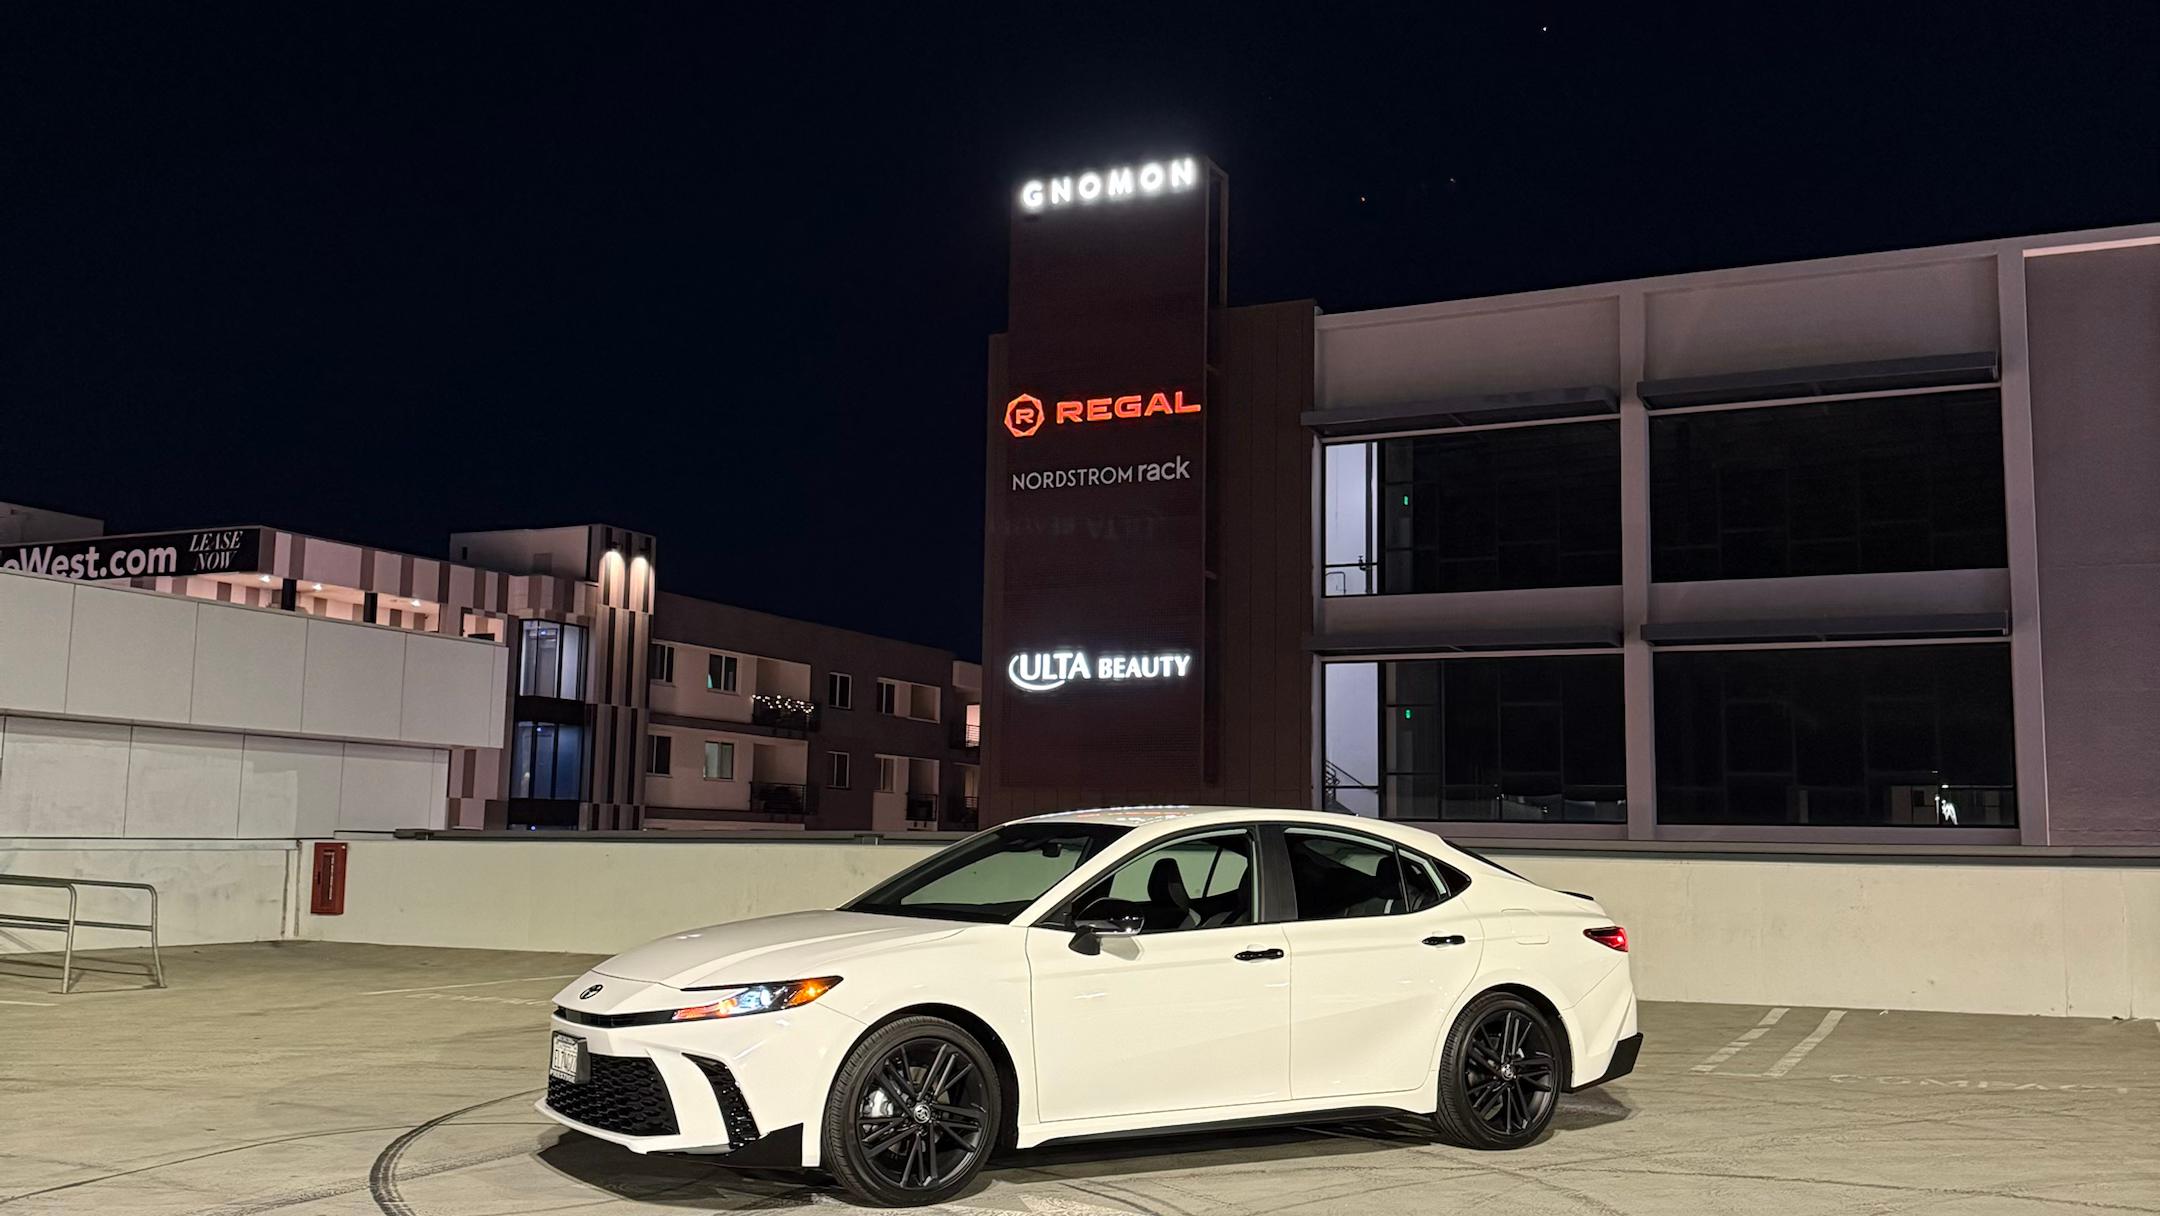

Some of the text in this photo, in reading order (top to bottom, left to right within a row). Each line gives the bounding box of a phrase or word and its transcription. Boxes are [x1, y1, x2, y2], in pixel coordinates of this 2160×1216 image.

[1022, 157, 1193, 207] GNOMON
[1056, 391, 1201, 424] REGAL
[1012, 455, 1191, 491] NORDSTROM rack
[189, 530, 243, 552] LEASE
[193, 550, 238, 571] NOW
[1011, 652, 1191, 686] ULTA BEAUTY
